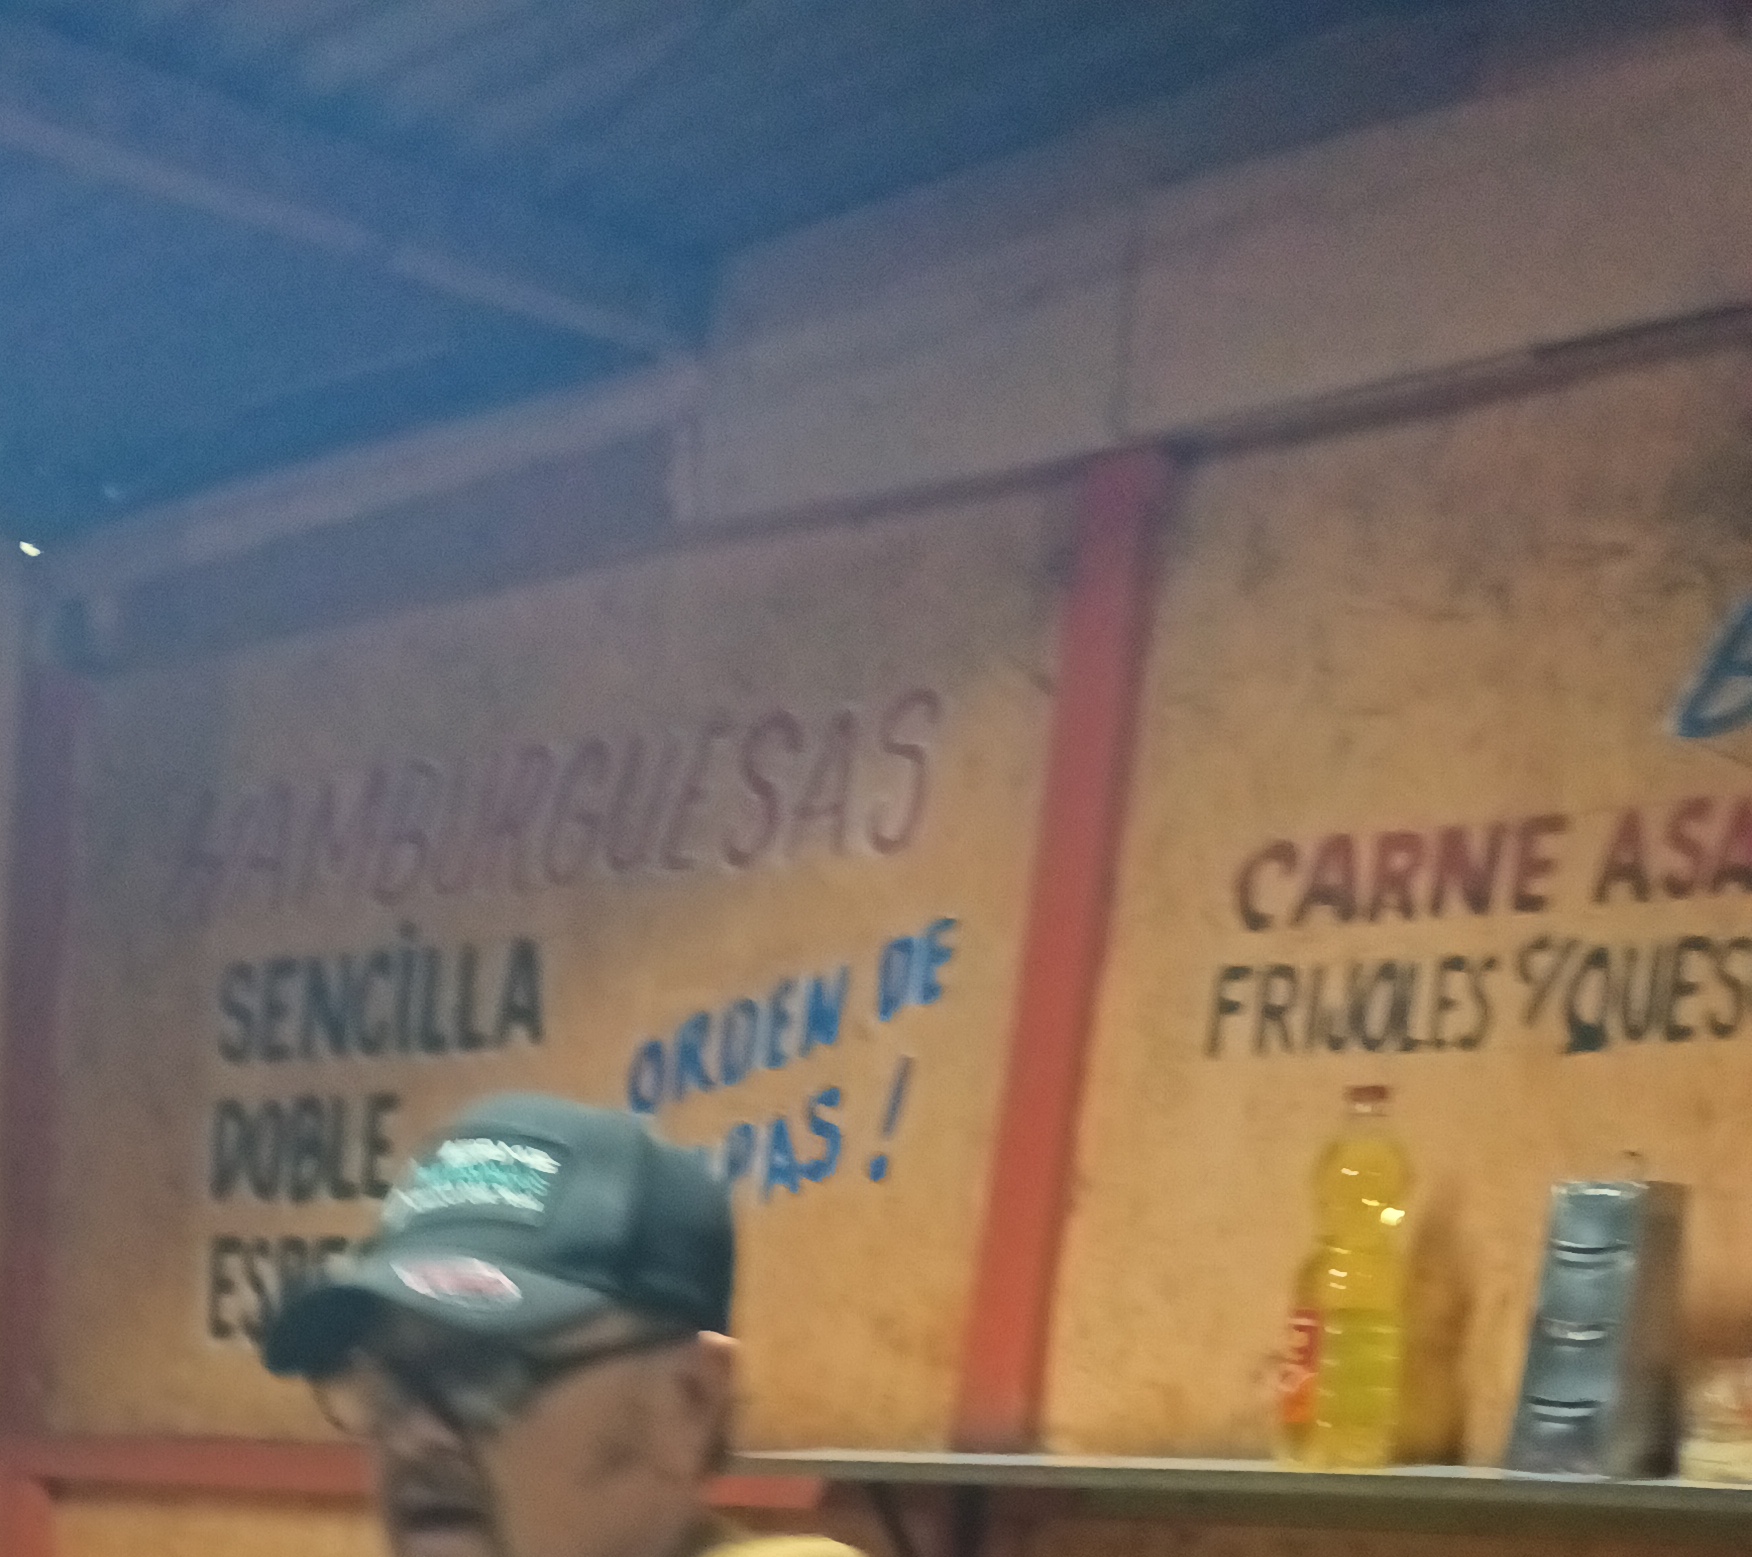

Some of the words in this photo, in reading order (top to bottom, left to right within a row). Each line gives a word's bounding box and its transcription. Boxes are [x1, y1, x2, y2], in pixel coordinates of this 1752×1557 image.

[163, 690, 942, 926] HAMBURGUESAS
[1233, 812, 1570, 933] CARNE
[626, 963, 853, 1118] ORDEN
[876, 915, 960, 1023] DE
[209, 1091, 401, 1206] DOBLE
